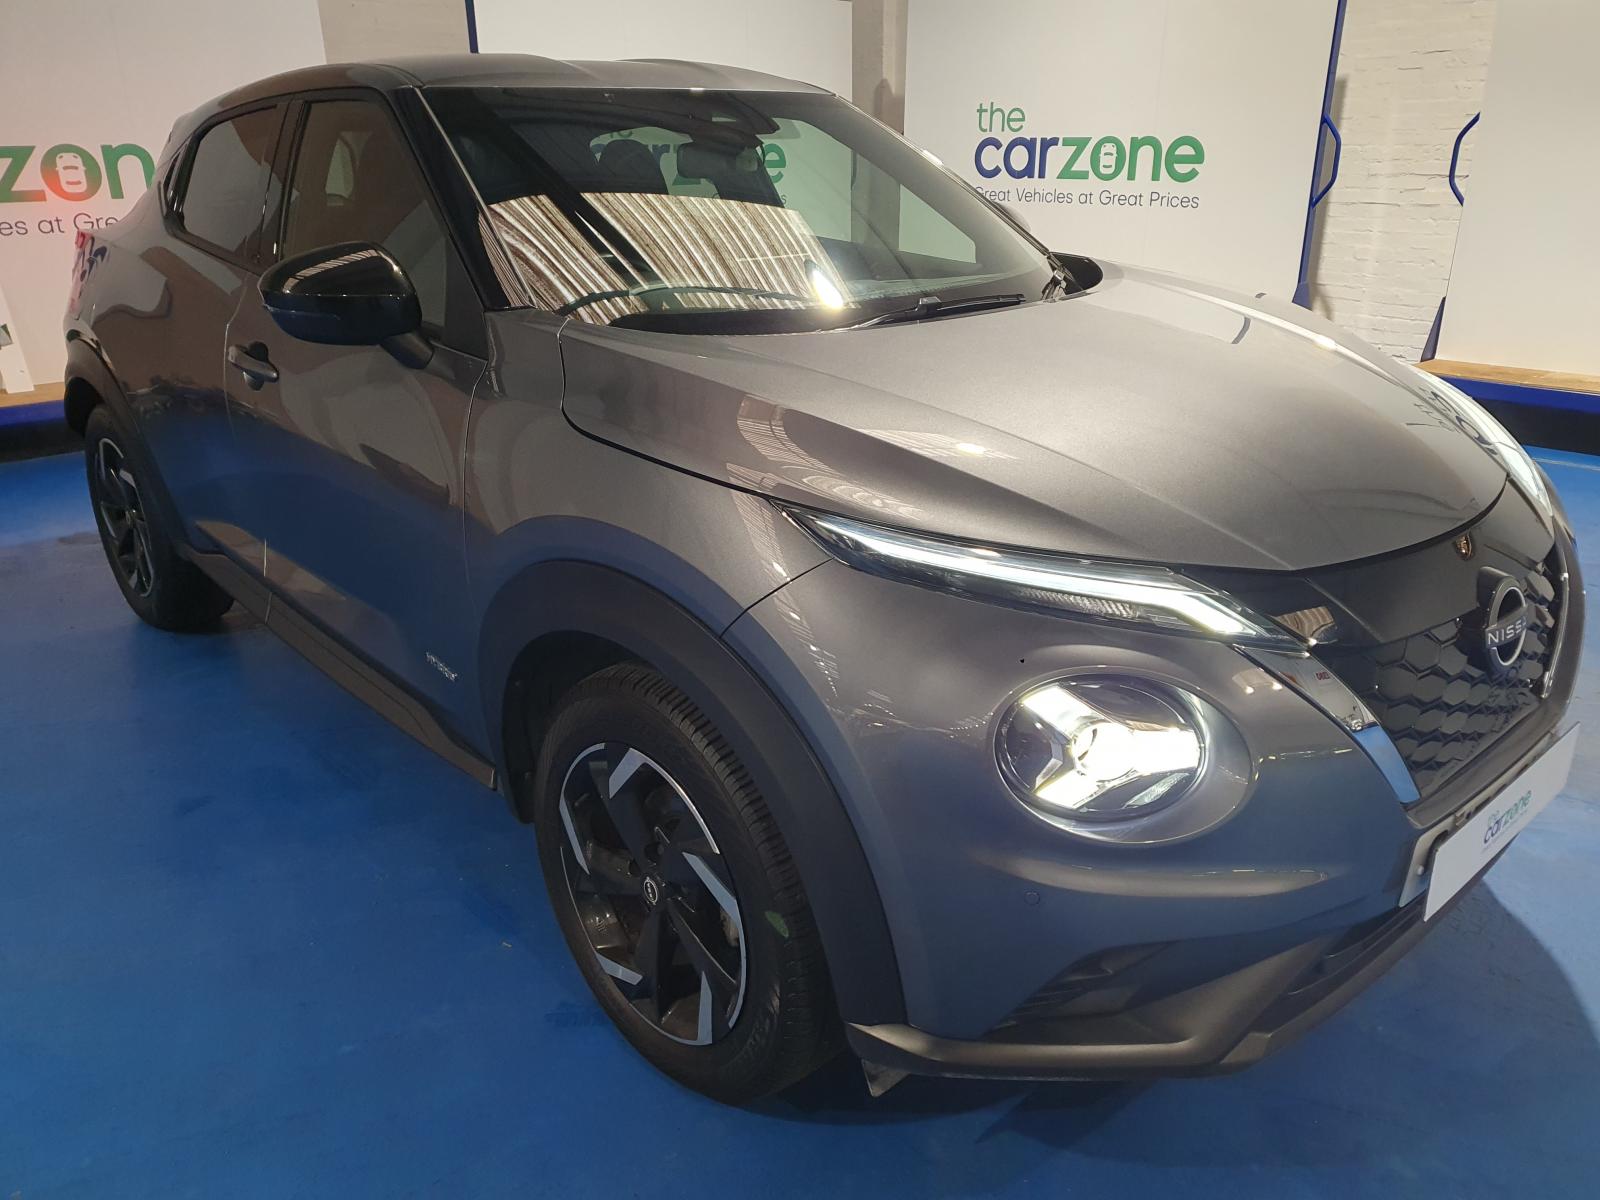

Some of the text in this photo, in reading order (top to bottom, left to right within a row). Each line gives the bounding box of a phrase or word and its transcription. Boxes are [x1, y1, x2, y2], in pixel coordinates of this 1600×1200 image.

[976, 101, 1026, 133] the
[974, 135, 1205, 183] carzone
[1015, 187, 1073, 204] Vehicles
[1078, 190, 1094, 205] at
[1099, 189, 1144, 207] Great
[1149, 191, 1200, 209] Prices
[37, 215, 65, 234] at
